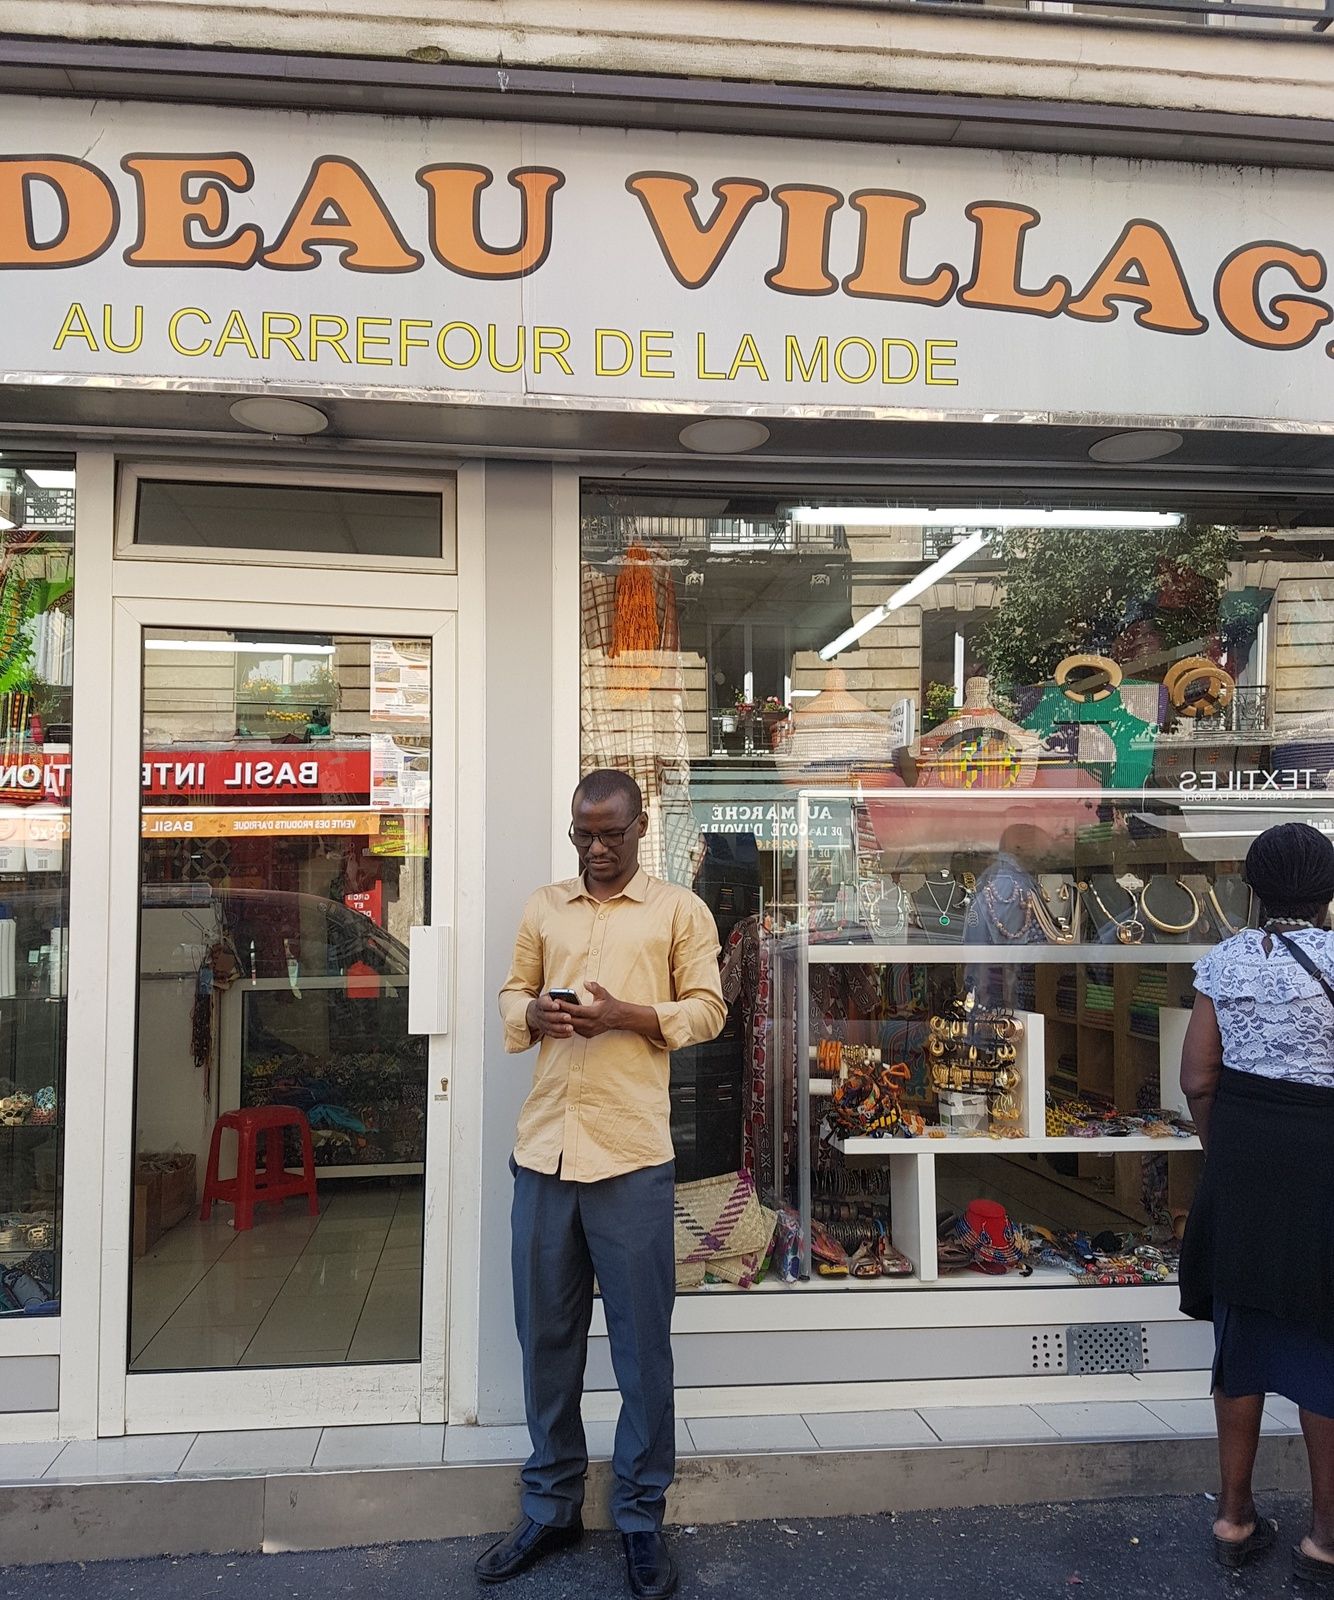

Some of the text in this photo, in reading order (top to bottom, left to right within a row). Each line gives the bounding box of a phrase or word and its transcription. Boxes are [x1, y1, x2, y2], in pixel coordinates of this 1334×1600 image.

[0, 152, 1334, 360] DEAU VILLAG
[52, 302, 960, 387] AU CARREFOUR DE LA MODE
